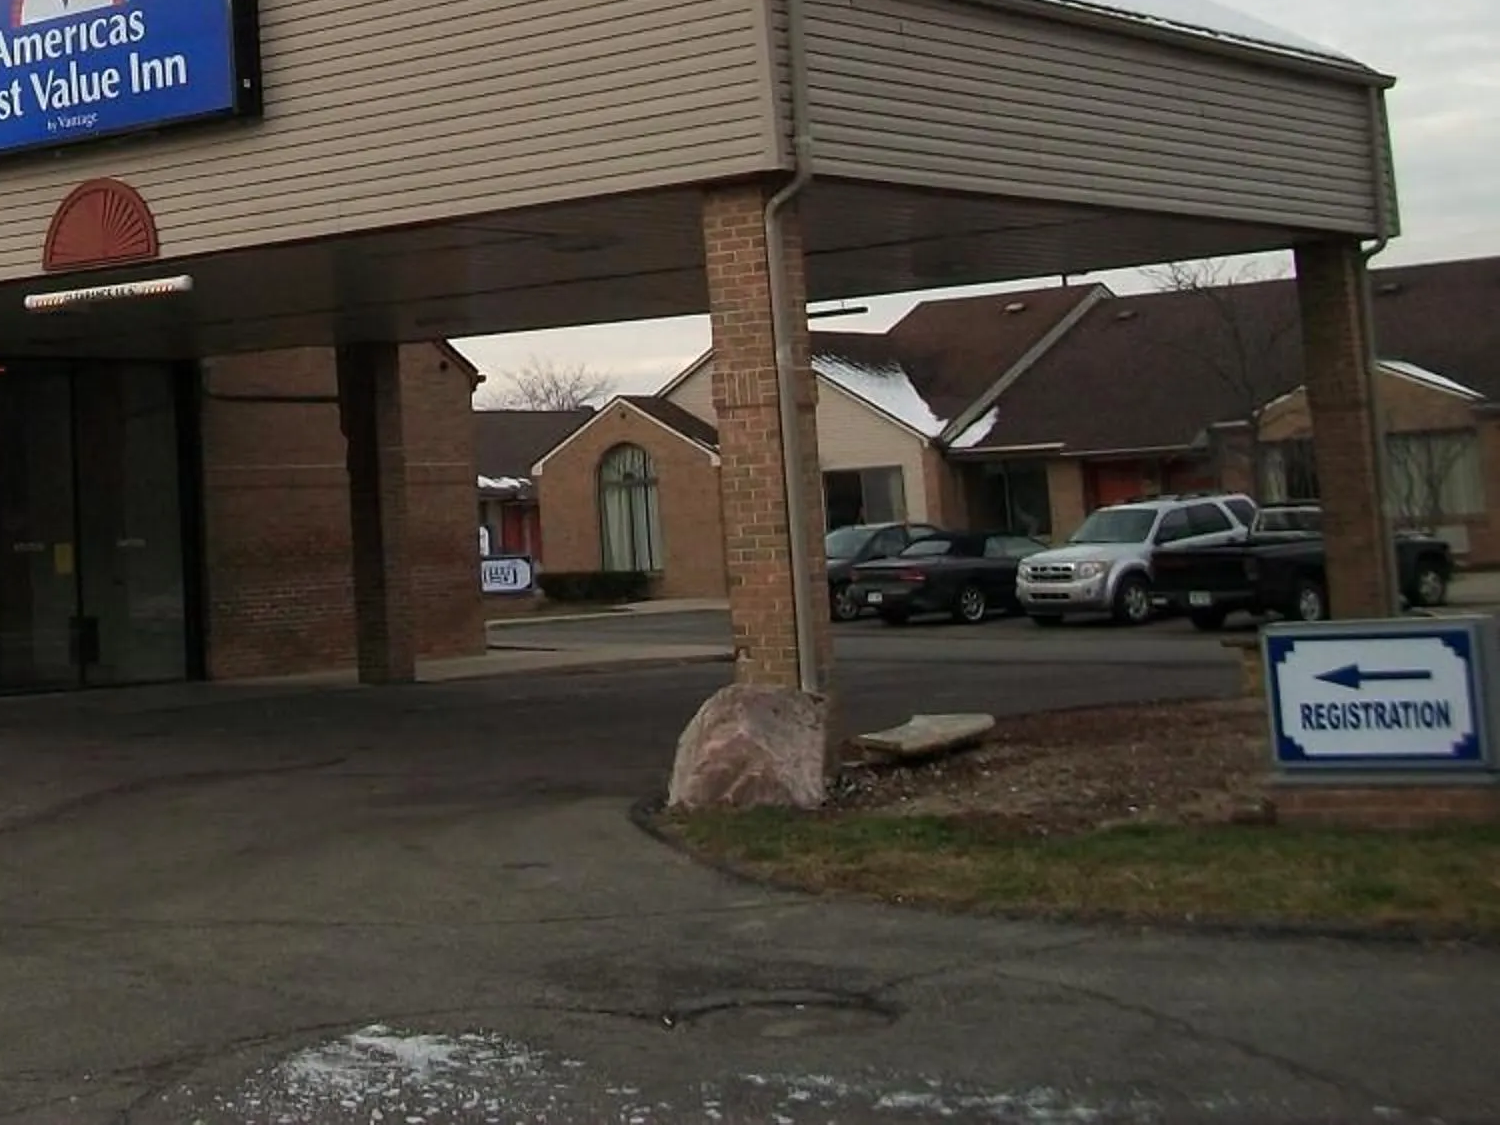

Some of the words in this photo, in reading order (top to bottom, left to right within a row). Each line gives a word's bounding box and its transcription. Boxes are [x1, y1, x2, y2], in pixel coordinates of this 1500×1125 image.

[30, 61, 120, 112] Value
[129, 52, 187, 94] Inn
[1300, 699, 1451, 730] REGISTRATION
